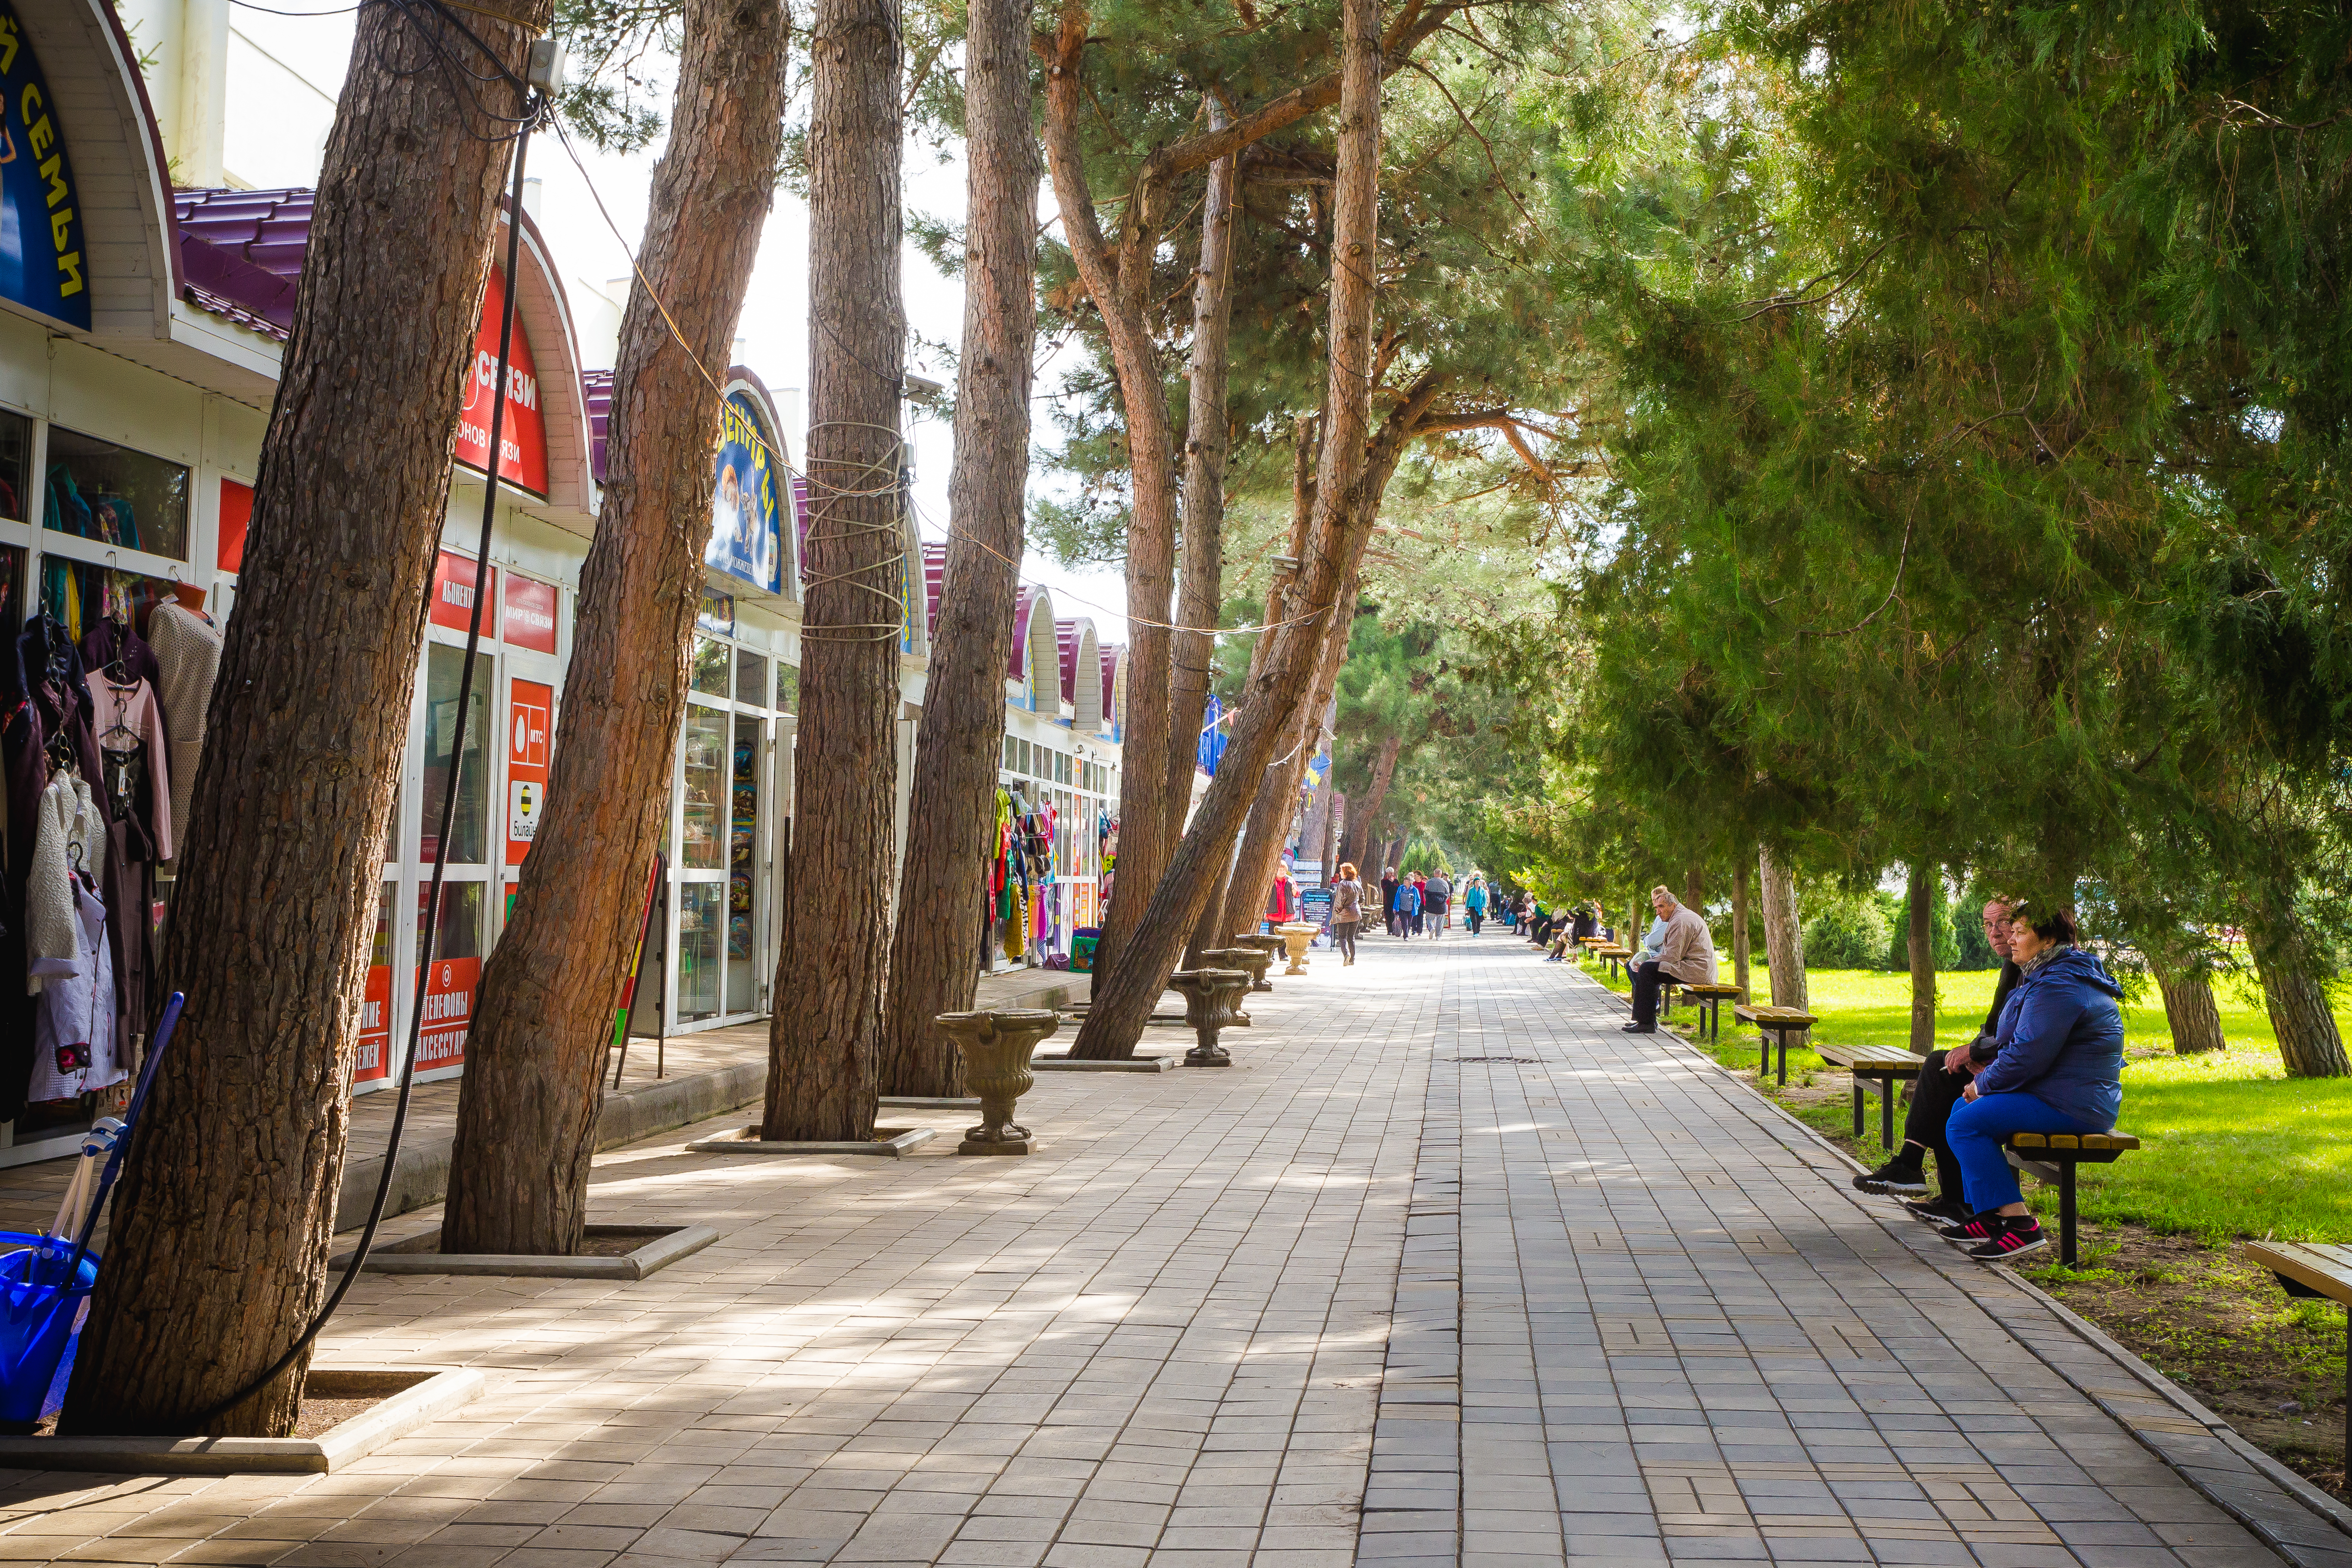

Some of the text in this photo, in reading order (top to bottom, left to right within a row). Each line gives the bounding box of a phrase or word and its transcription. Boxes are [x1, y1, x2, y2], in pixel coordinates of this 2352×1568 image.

[21, 83, 83, 298] СЕМЬИ
[489, 433, 520, 464] ЯЗИ
[505, 605, 553, 630] МИР СВЯЗИ
[530, 729, 543, 744] МТС
[424, 991, 468, 1021] ТЕЛЕФОНЫ
